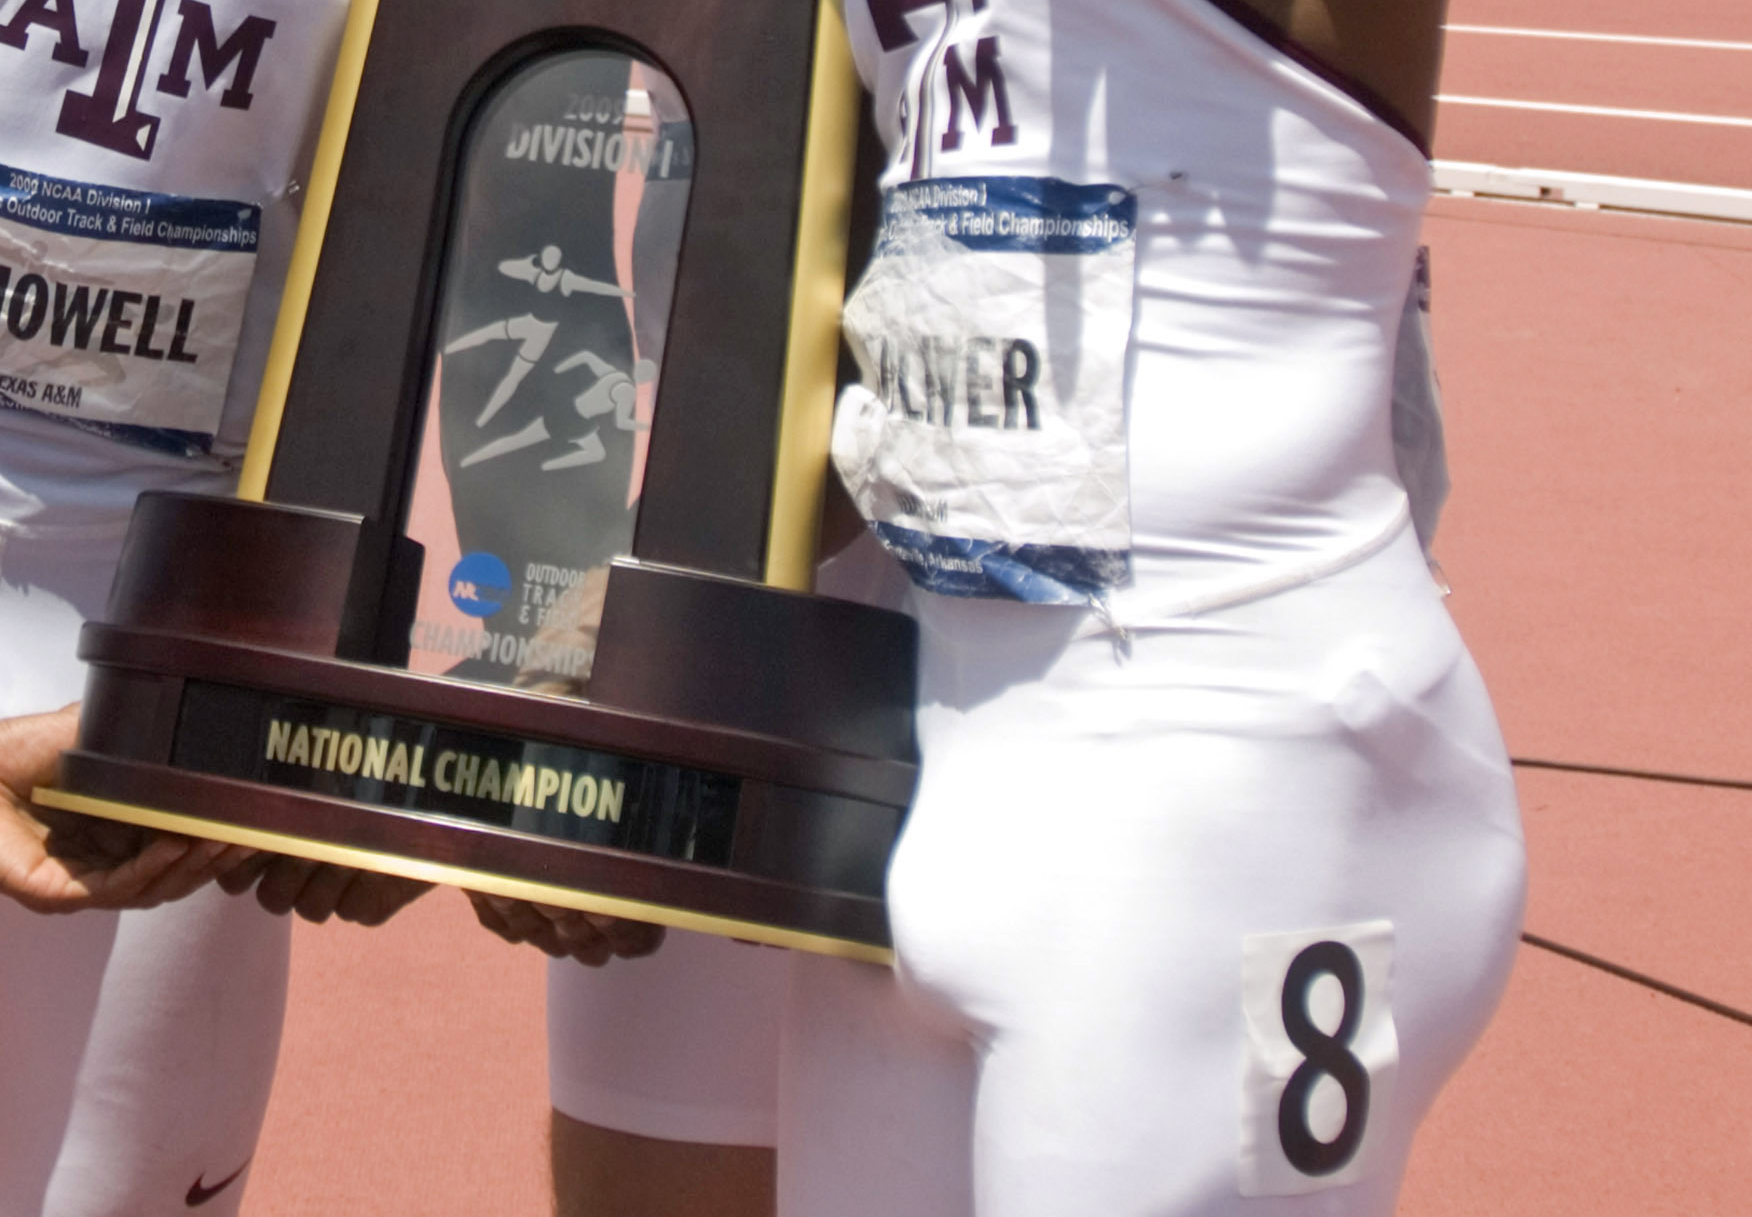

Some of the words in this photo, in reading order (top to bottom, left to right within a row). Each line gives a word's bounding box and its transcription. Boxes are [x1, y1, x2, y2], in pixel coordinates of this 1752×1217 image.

[505, 123, 655, 176] DIVISION
[42, 182, 83, 203] NCAA
[87, 190, 143, 213] Division
[7, 198, 64, 225] Outdoor
[67, 209, 104, 233] Track
[107, 217, 118, 234] &
[121, 219, 154, 238] Field
[157, 221, 258, 246] Championships
[949, 211, 959, 235] &
[961, 210, 994, 236] Field
[999, 210, 1128, 242] Championships
[42, 384, 82, 408] A&M
[266, 720, 426, 787] NATIONAL
[434, 750, 626, 823] CHAMPION
[1278, 939, 1371, 1177] 8
